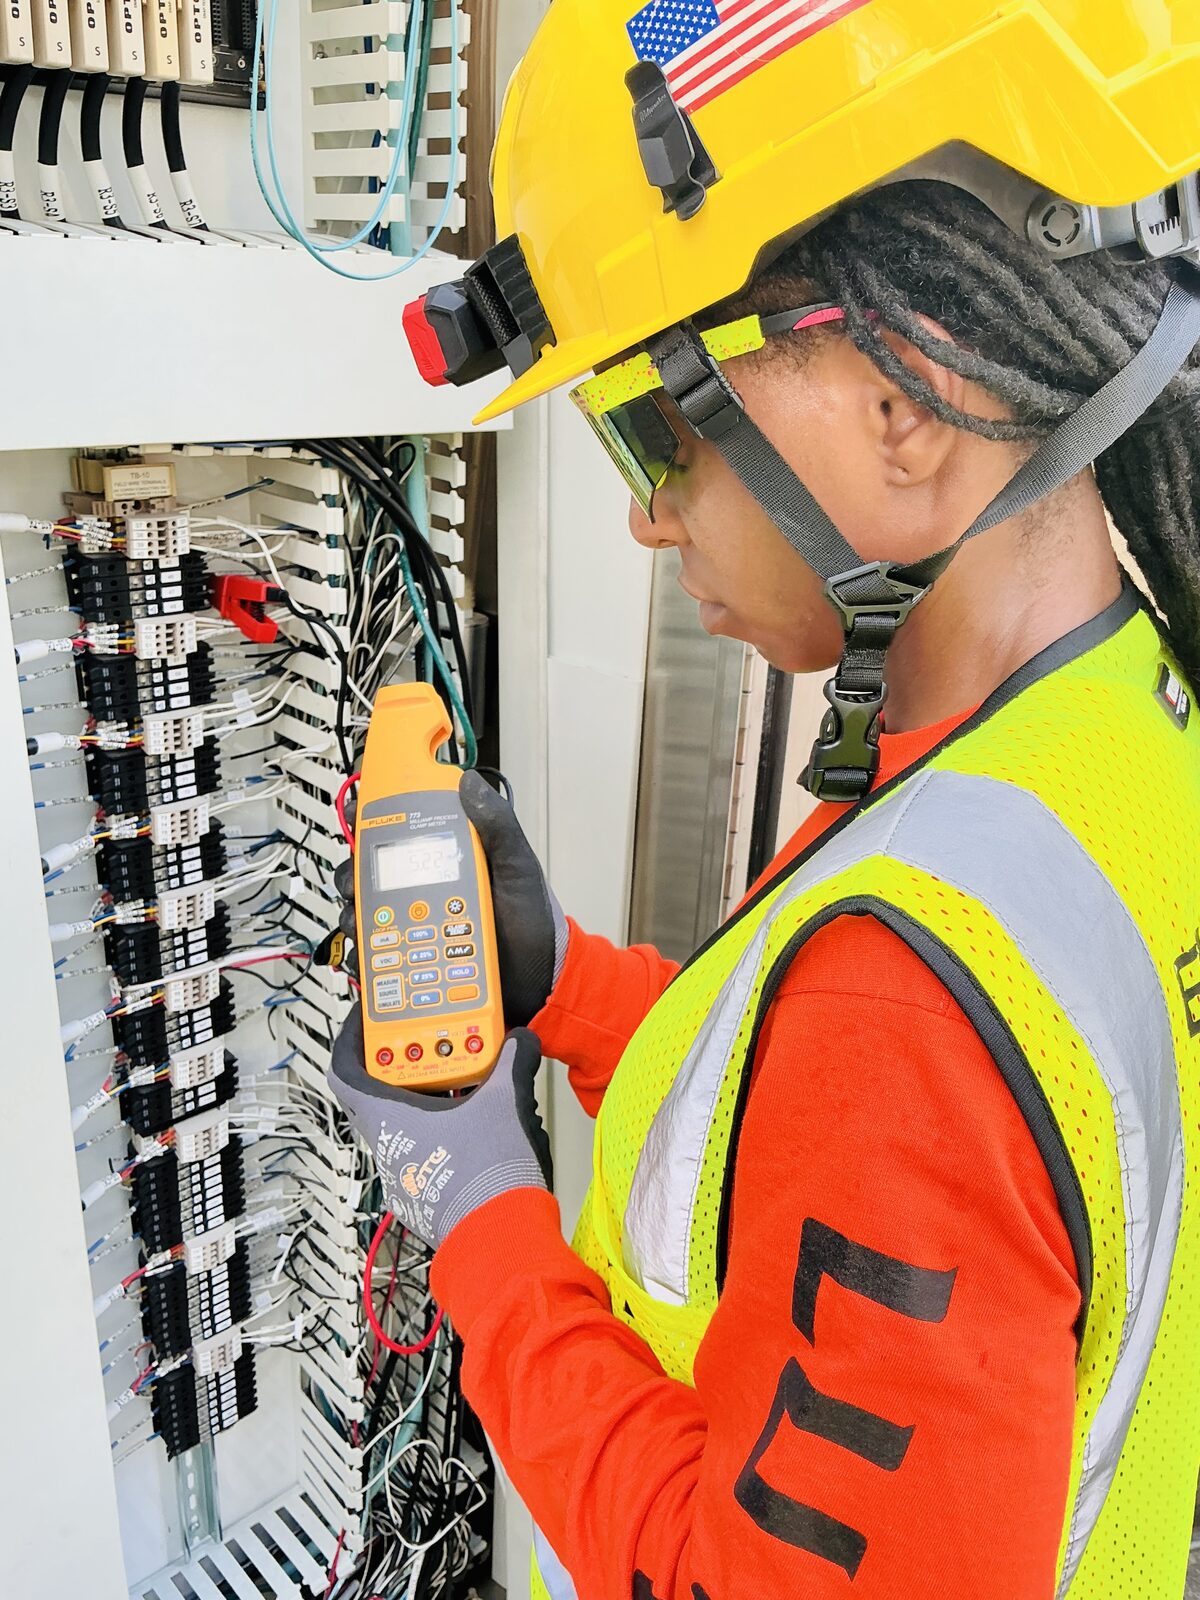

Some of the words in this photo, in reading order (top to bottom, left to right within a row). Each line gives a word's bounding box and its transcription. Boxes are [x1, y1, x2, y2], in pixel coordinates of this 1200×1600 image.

[11, 0, 20, 18] O
[18, 36, 26, 47] S
[56, 41, 63, 52] S
[94, 46, 101, 56] S
[131, 50, 138, 61] S
[166, 55, 173, 65] S
[200, 59, 207, 70] S
[179, 199, 202, 226] R3-S7
[368, 815, 402, 826] FLUKE
[412, 930, 429, 938] 100%
[421, 972, 435, 980] 25%
[451, 968, 470, 976] HOLD
[377, 978, 399, 987] MEASURE
[379, 989, 398, 997] SOURCE
[378, 1000, 401, 1009] SIMULATE
